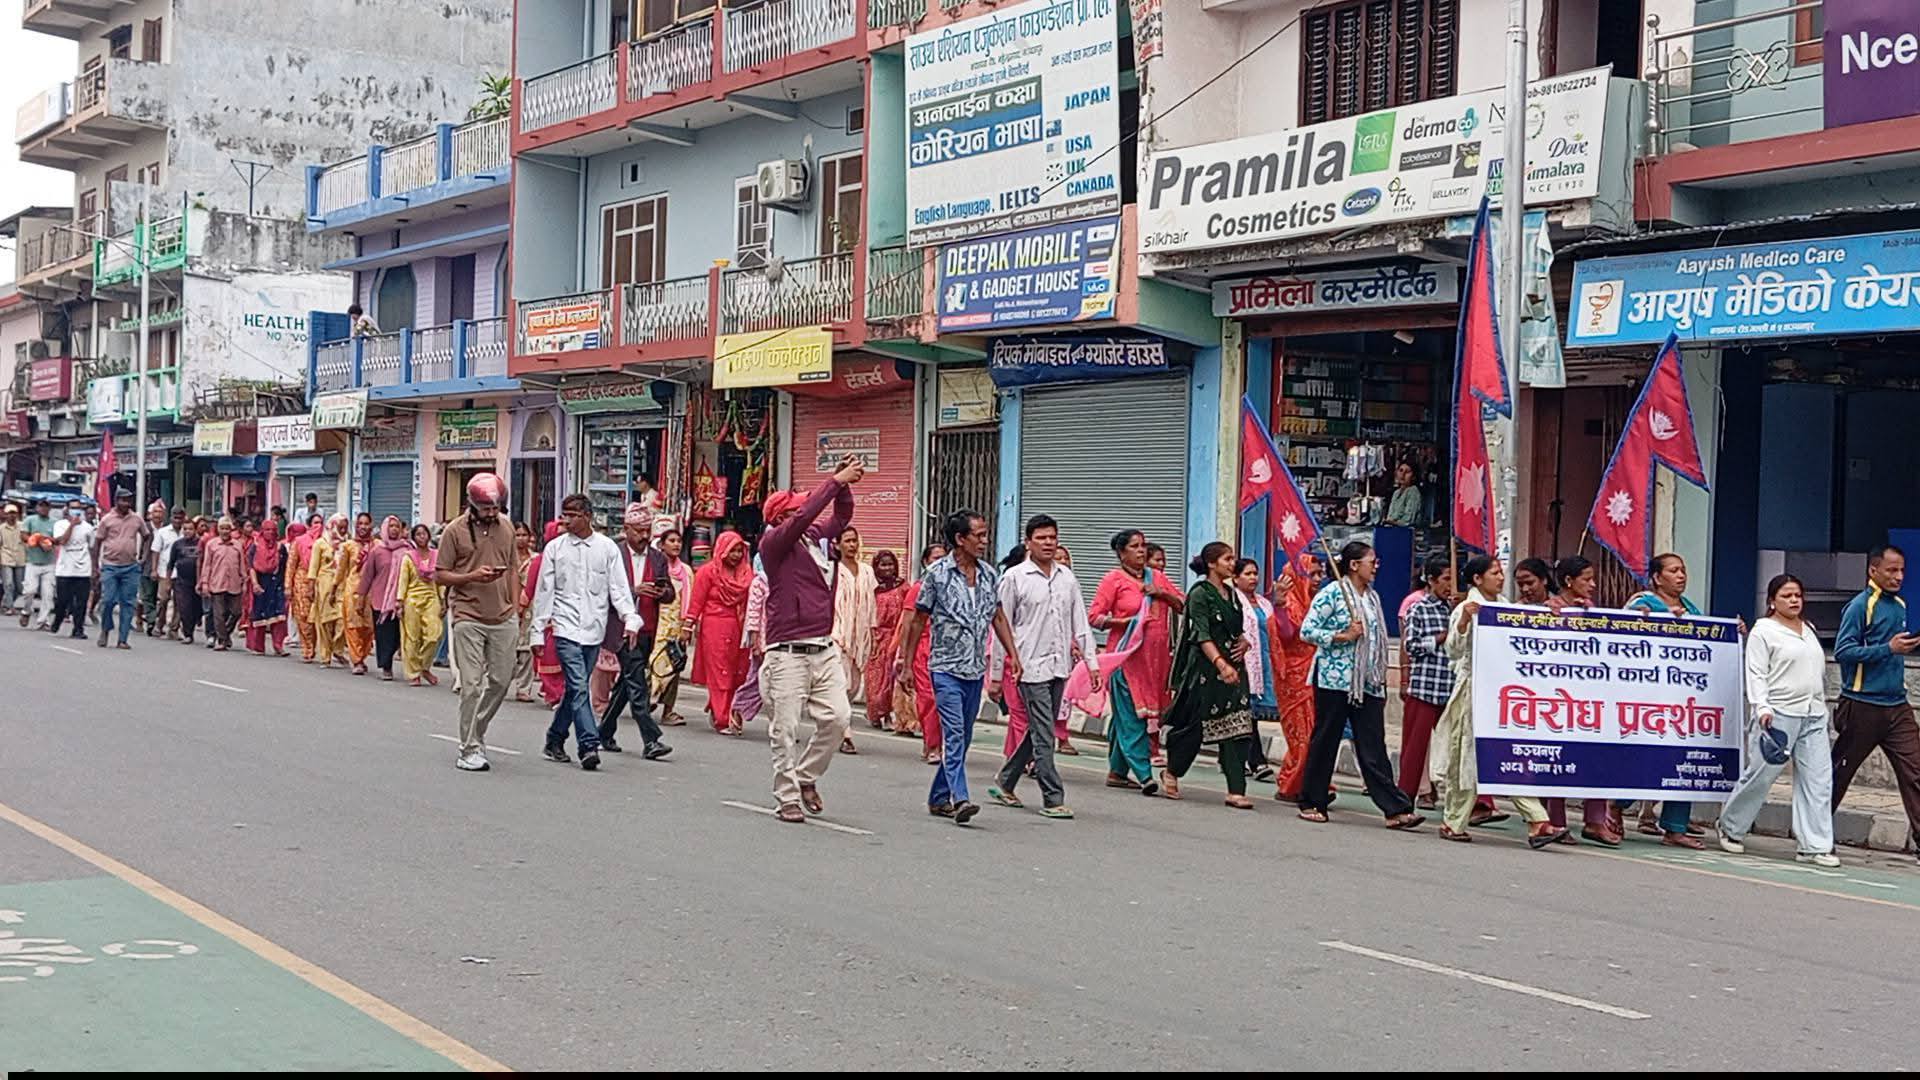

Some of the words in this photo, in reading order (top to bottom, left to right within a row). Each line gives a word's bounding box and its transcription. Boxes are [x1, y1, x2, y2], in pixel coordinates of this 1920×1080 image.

[995, 82, 1037, 106] कक्षा
[1064, 86, 1111, 111] JAPAN
[911, 126, 990, 165] कोरियन
[995, 114, 1042, 146] भाषा
[1403, 118, 1457, 140] derma
[1065, 135, 1092, 154] USA
[1548, 138, 1588, 158] Dove
[1066, 158, 1087, 175] UK
[1149, 131, 1346, 210] Pramila
[1066, 174, 1114, 197] CANADA
[915, 204, 946, 225] English
[1000, 186, 1041, 211] IELTS
[1206, 200, 1337, 240] Cosmetics
[945, 241, 1011, 278] DEEPAK
[1014, 230, 1084, 271] MOBILE
[1675, 253, 1736, 277] Aayush
[1739, 249, 1800, 271] Medico
[1804, 246, 1847, 265] Care
[969, 281, 980, 300] &
[982, 274, 1033, 299] GADGET
[1034, 269, 1081, 294] HOUSE
[1229, 277, 1316, 314] प्रमिला
[1321, 268, 1437, 304] कस्मेटिक
[1627, 286, 1718, 331] आयुष
[1725, 271, 1837, 319] मेडिको
[244, 313, 305, 330] HEALTH
[1127, 343, 1165, 366] हाउस
[1607, 639, 1653, 658] बस्ती
[1659, 644, 1712, 662] उठाउने
[1516, 661, 1610, 682] सरकारको
[1618, 666, 1660, 683] कार्य
[1498, 685, 1604, 731] विरोध
[1616, 697, 1725, 739] प्रदर्शन
